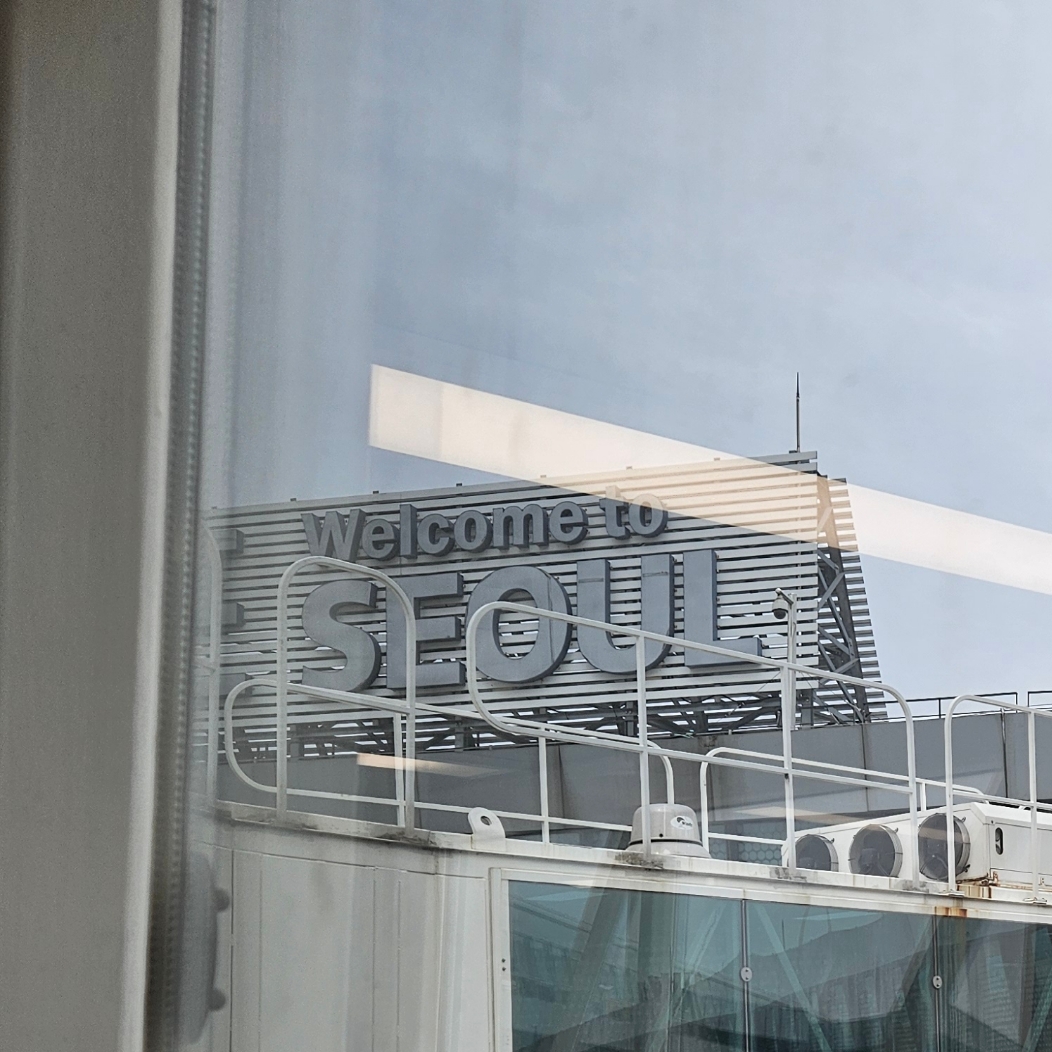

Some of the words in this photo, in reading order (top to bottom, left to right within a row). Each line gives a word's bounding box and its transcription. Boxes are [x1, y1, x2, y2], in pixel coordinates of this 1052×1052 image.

[301, 500, 589, 562] Welcome
[600, 486, 669, 541] to
[301, 549, 763, 692] SEOUL
